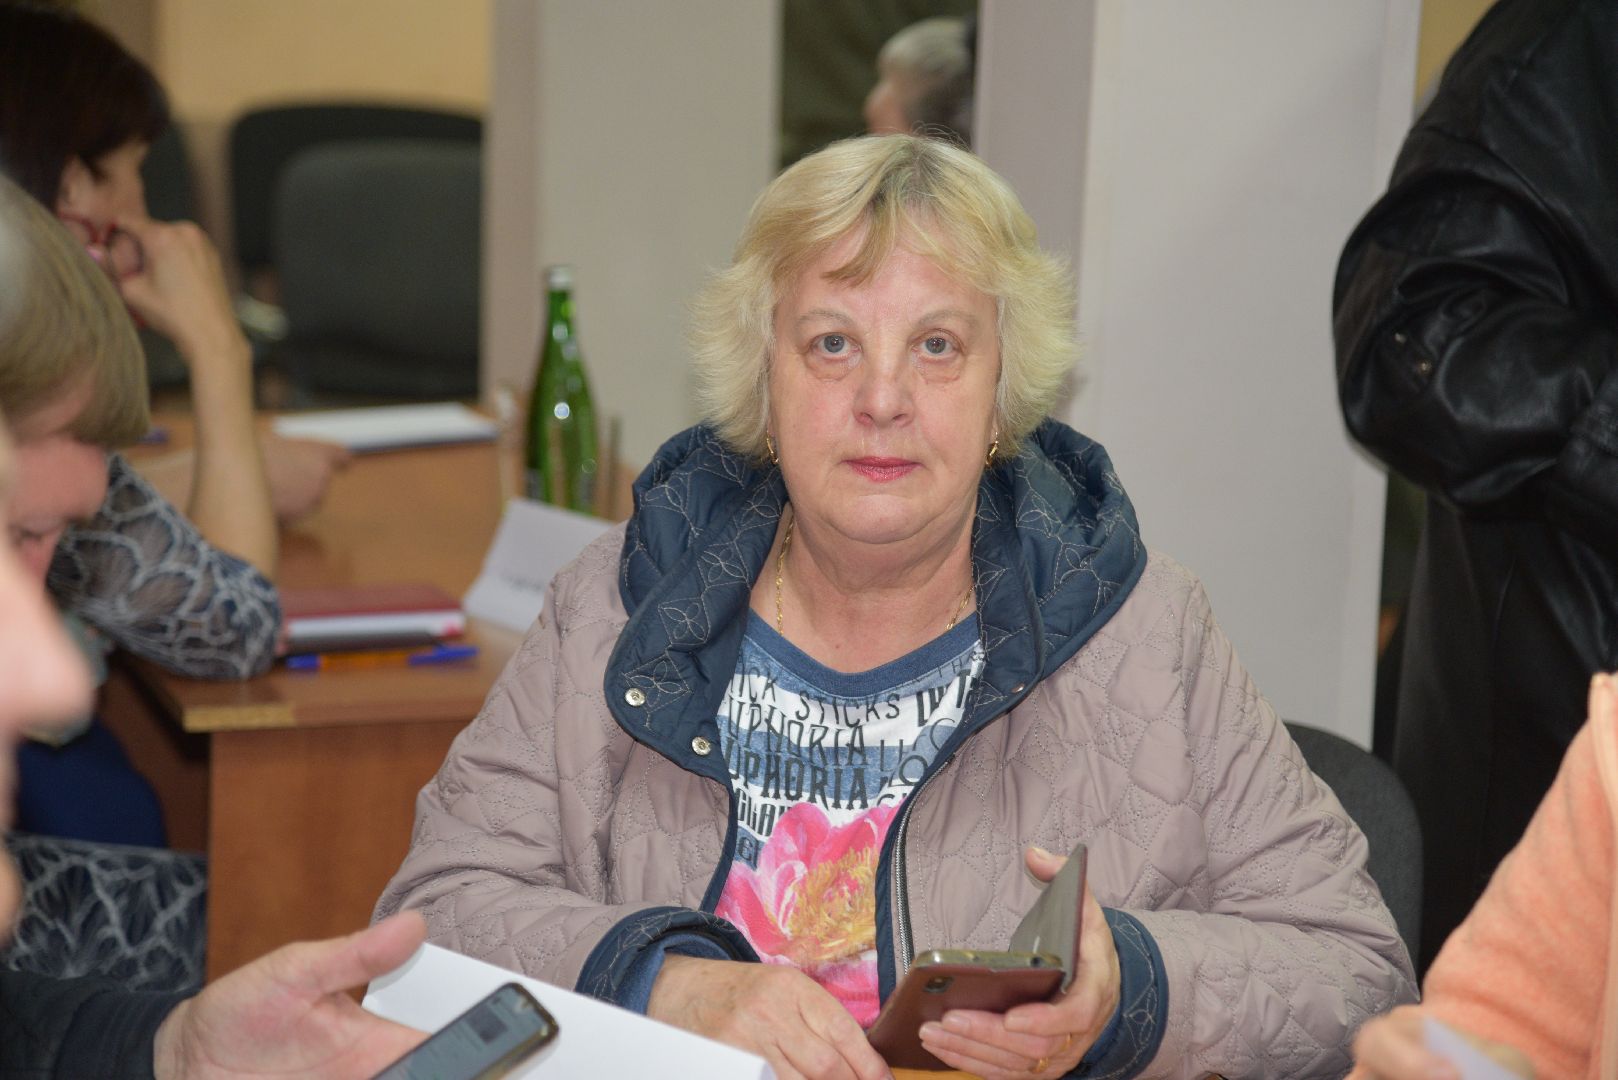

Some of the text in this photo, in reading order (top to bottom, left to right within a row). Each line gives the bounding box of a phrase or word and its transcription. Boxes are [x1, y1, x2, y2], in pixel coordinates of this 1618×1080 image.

[731, 661, 777, 702] ICK
[795, 690, 900, 728] STICKS
[726, 696, 868, 767] UPHORIA
[725, 736, 870, 810] UPHORIA
